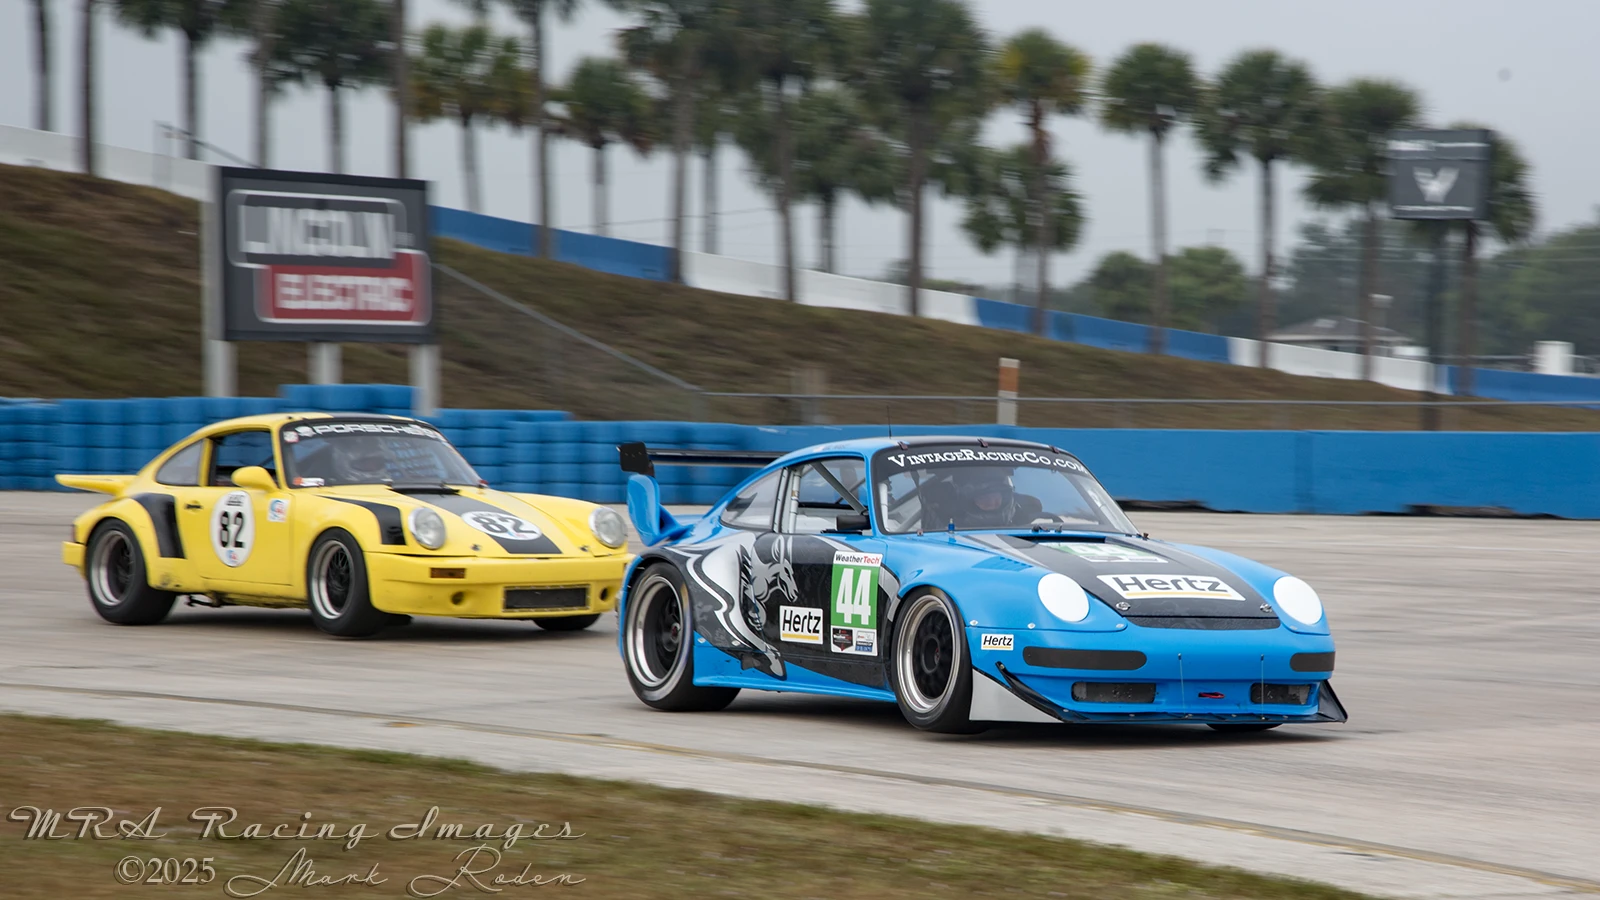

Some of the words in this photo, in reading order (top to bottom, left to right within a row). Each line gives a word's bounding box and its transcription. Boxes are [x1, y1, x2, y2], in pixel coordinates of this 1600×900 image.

[273, 273, 413, 312] ELECTRIC
[219, 510, 245, 548] 82
[471, 516, 537, 534] 82
[835, 554, 880, 564] WeatherTech
[1111, 576, 1229, 593] Hertz
[836, 567, 872, 625] 44
[782, 609, 821, 634] Hertz
[982, 635, 1013, 646] Hertz
